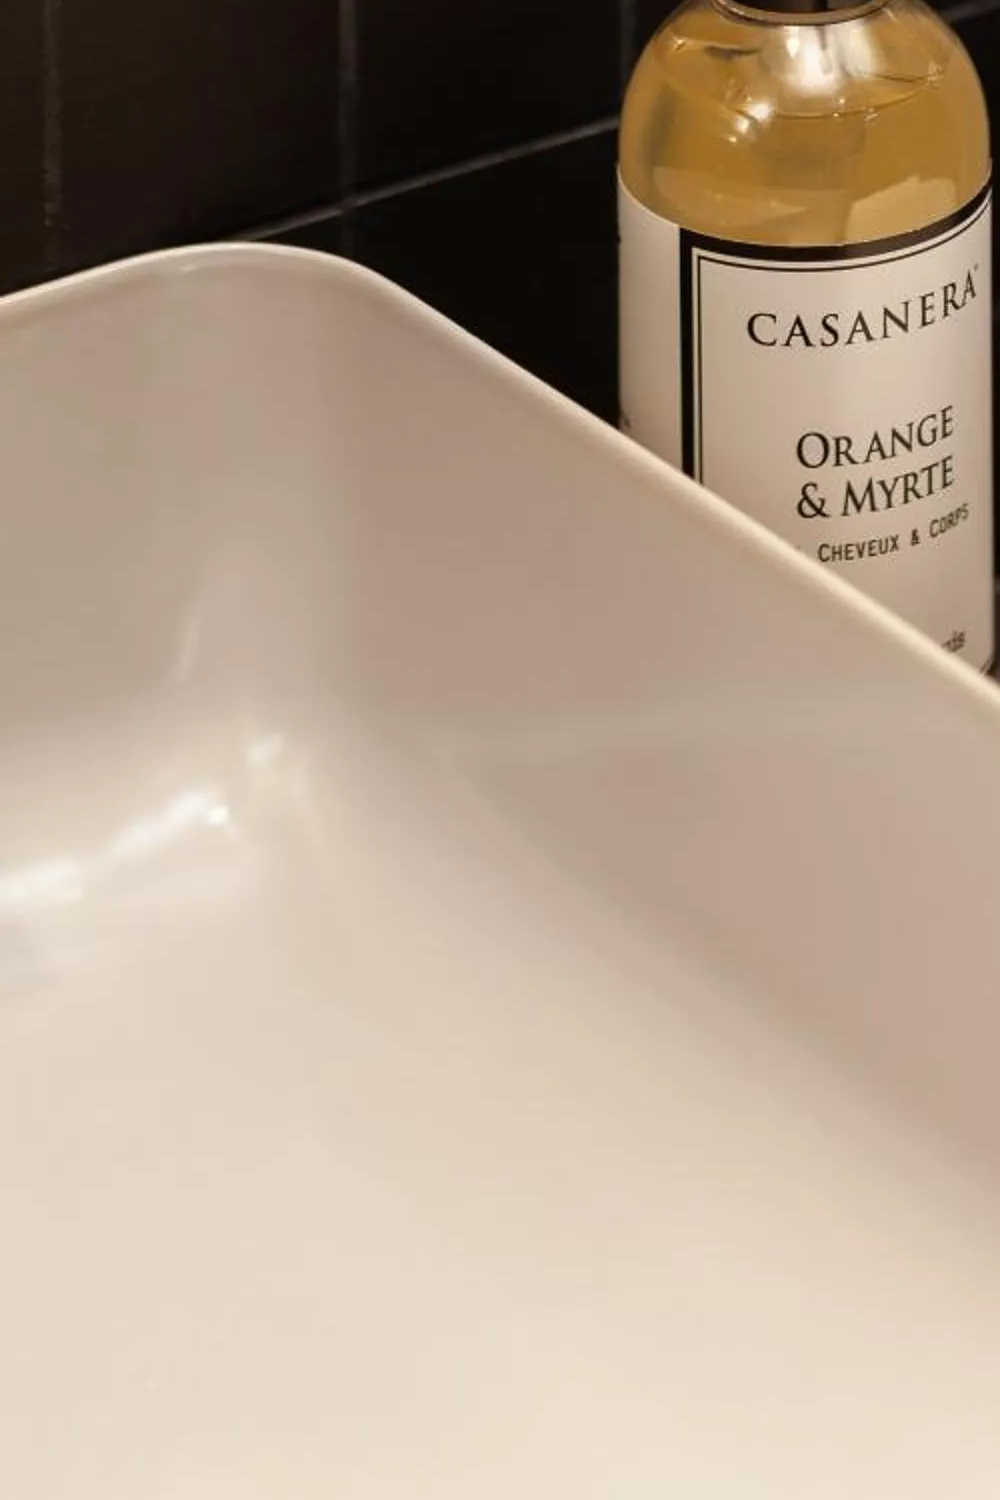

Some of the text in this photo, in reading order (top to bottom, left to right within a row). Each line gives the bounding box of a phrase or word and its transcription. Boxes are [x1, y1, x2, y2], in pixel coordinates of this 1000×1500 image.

[746, 270, 977, 347] CASANERA
[796, 404, 954, 469] ORANGE
[796, 454, 955, 519] & MYRTE
[817, 502, 970, 563] CHEVEUX & CORPS
